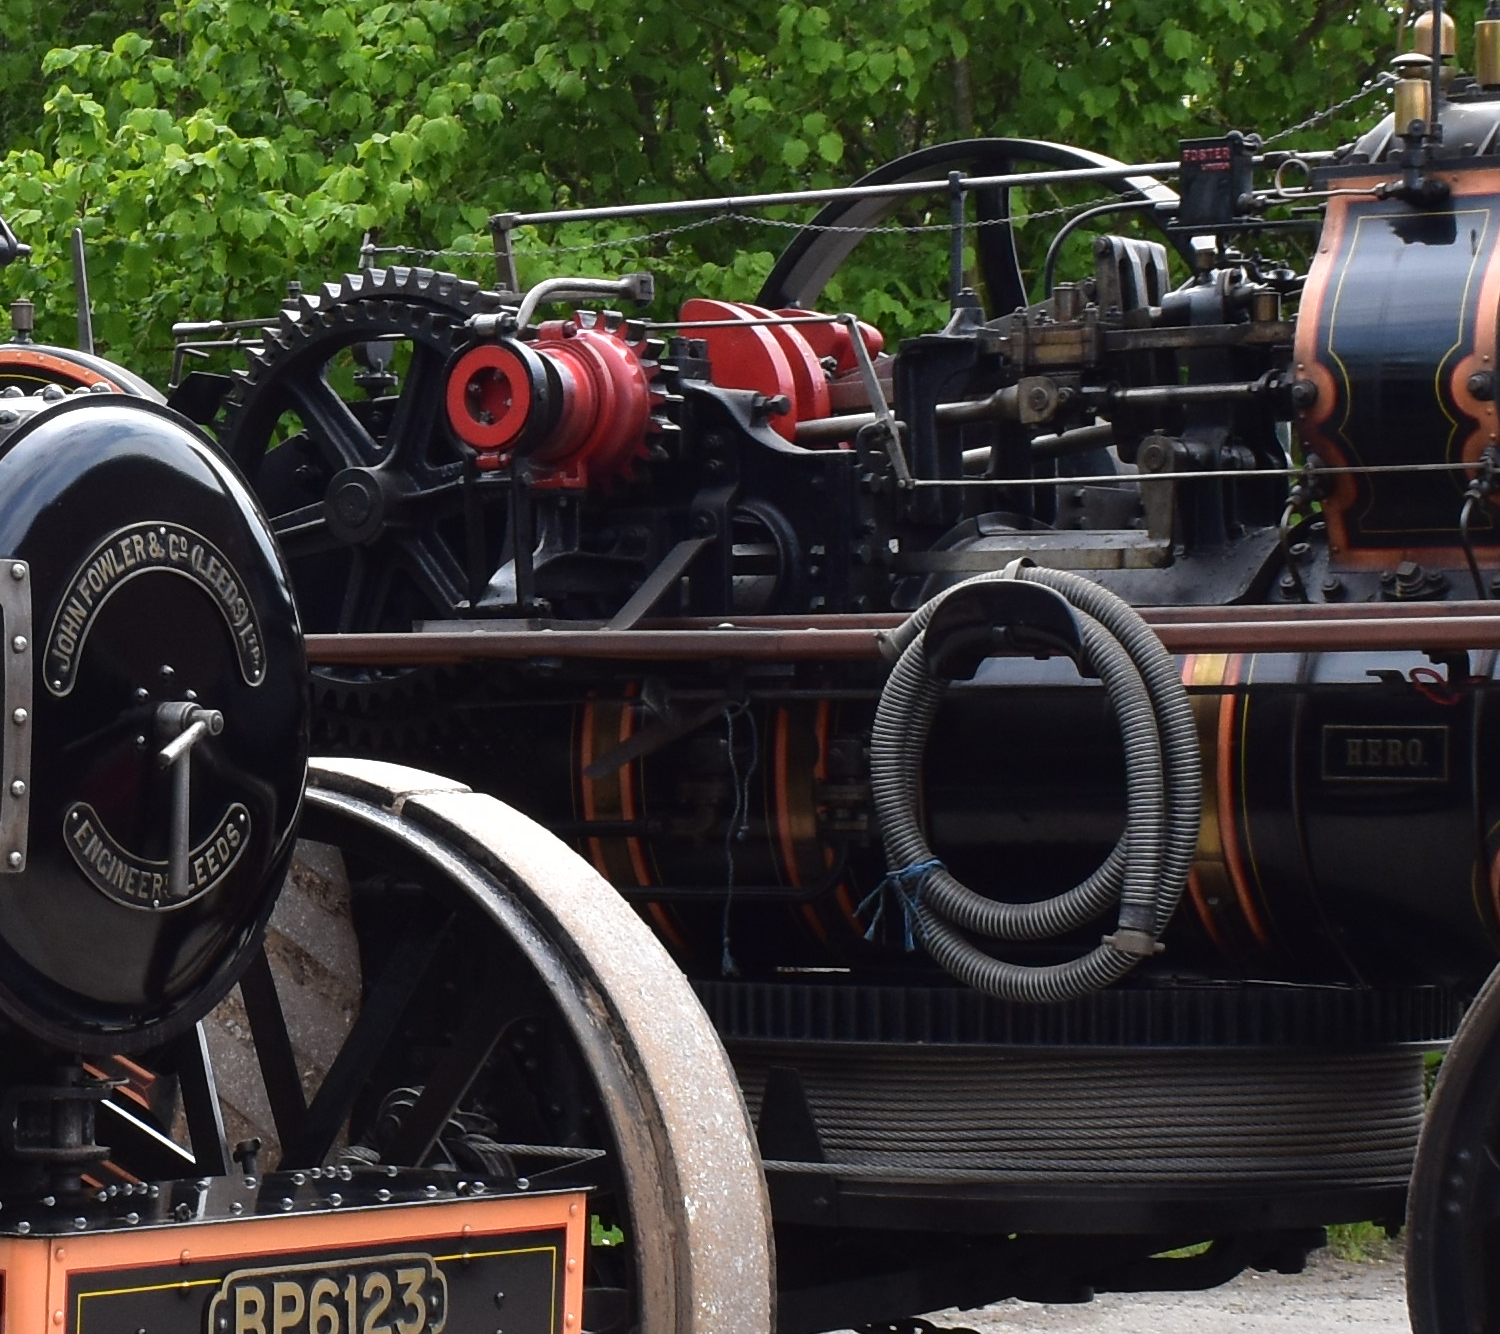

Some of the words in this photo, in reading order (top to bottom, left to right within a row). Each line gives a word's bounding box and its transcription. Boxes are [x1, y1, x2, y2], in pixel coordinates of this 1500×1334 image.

[52, 596, 88, 673] JOHN
[77, 534, 146, 606] FOWLER
[149, 531, 165, 558] &
[191, 543, 249, 627] (LEEDS)
